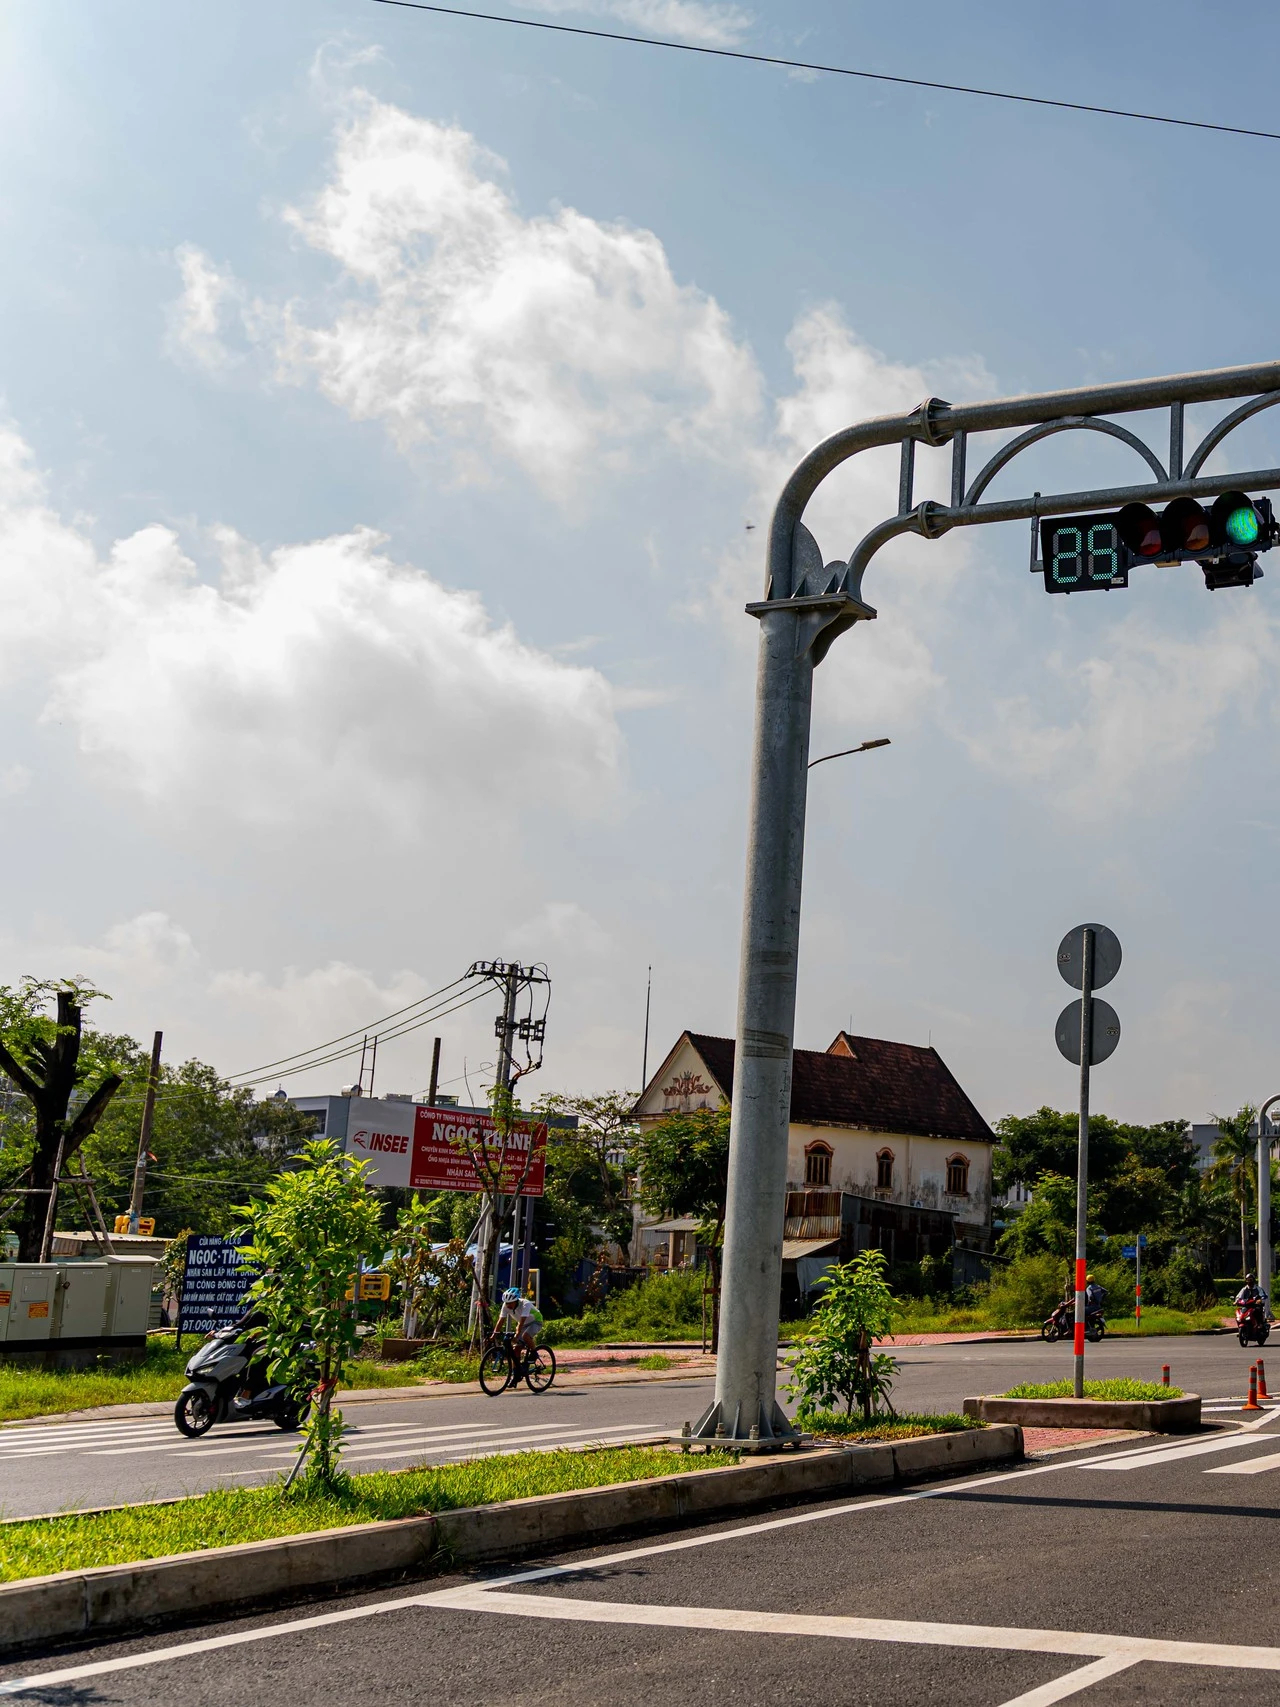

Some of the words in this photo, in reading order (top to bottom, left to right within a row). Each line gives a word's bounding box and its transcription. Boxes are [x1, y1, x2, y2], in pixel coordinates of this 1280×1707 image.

[420, 1109, 436, 1119] CÔNG
[432, 1122, 479, 1147] NGỌC
[369, 1132, 410, 1154] INSEE
[197, 1280, 216, 1289] CÔNG
